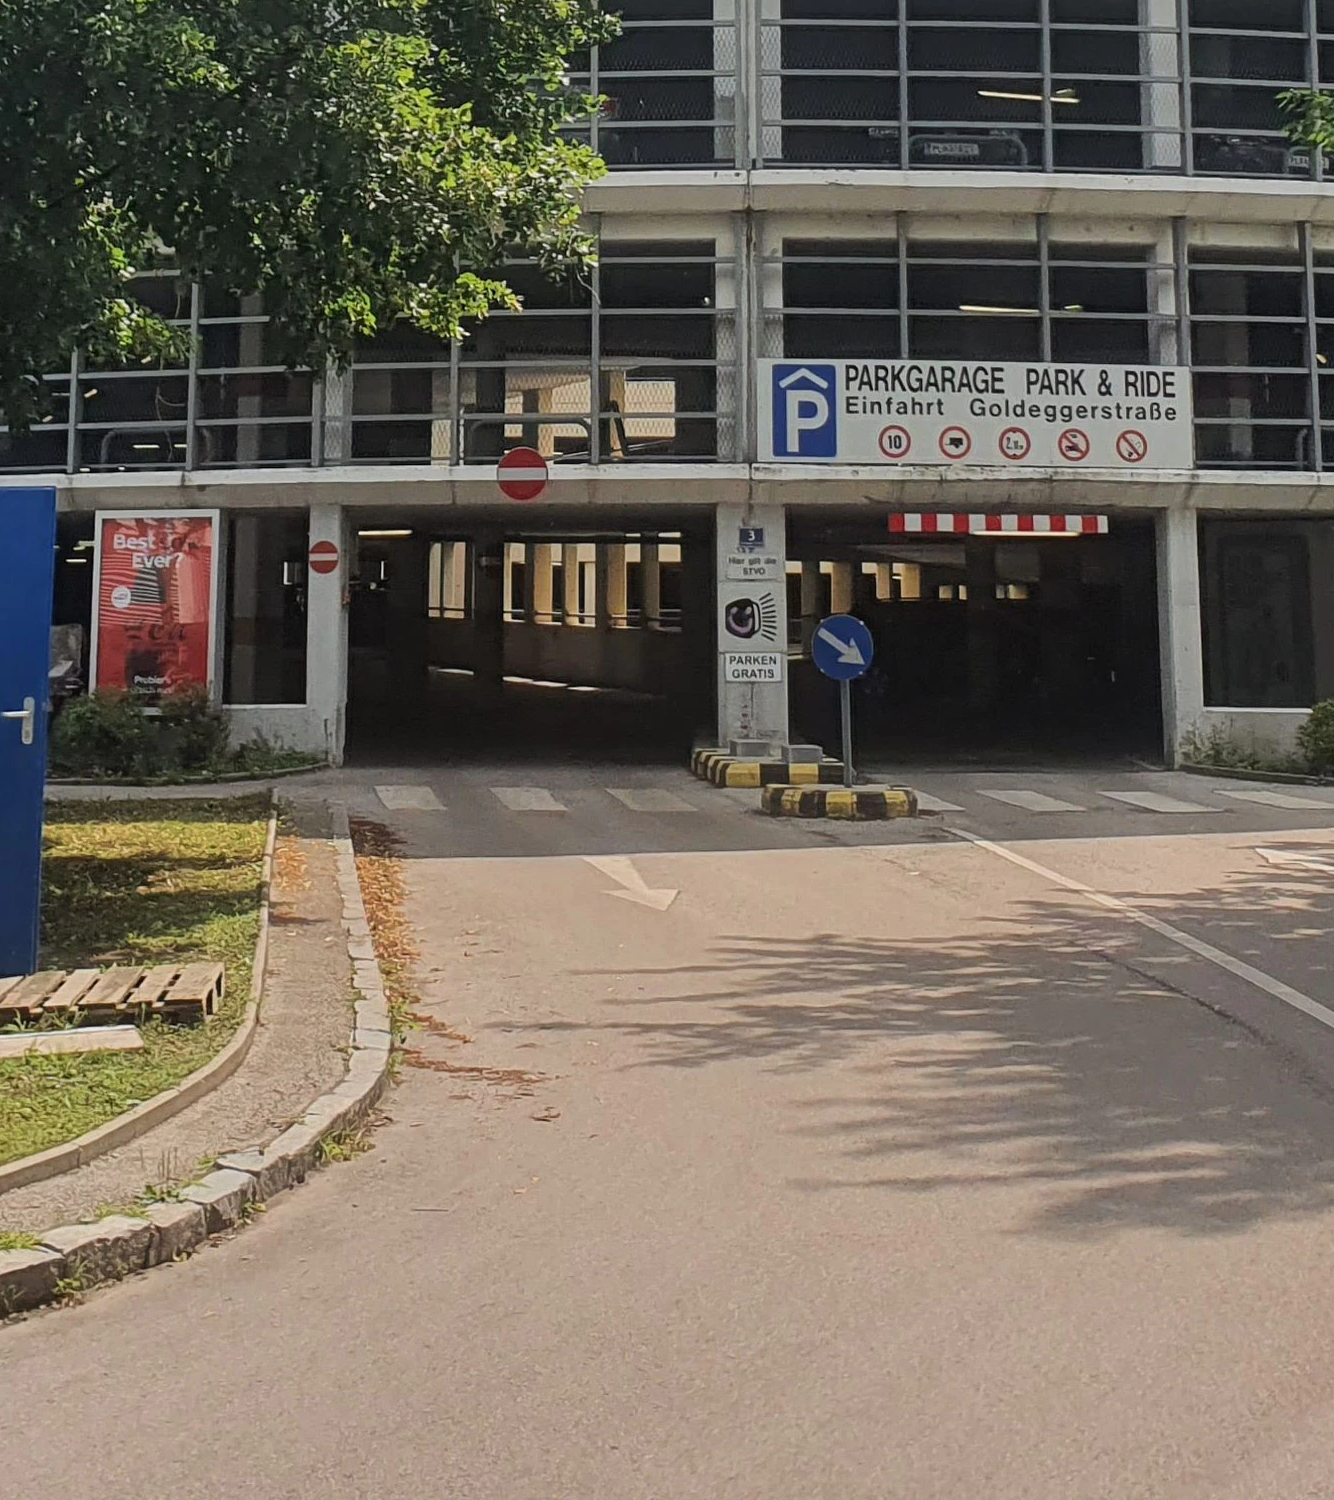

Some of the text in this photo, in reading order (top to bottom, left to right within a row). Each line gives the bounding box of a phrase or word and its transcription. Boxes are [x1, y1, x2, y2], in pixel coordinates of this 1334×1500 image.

[845, 364, 1176, 398] PARKGARAGE PARK & RIDE
[845, 396, 1177, 423] Einfahrt Goldeggerstraße
[786, 389, 829, 453] P
[887, 434, 903, 449] 10
[113, 530, 156, 550] Best
[747, 530, 756, 541] 3
[132, 552, 185, 568] Ever?
[729, 655, 777, 665] PARKEN
[732, 668, 774, 679] GRATIS
